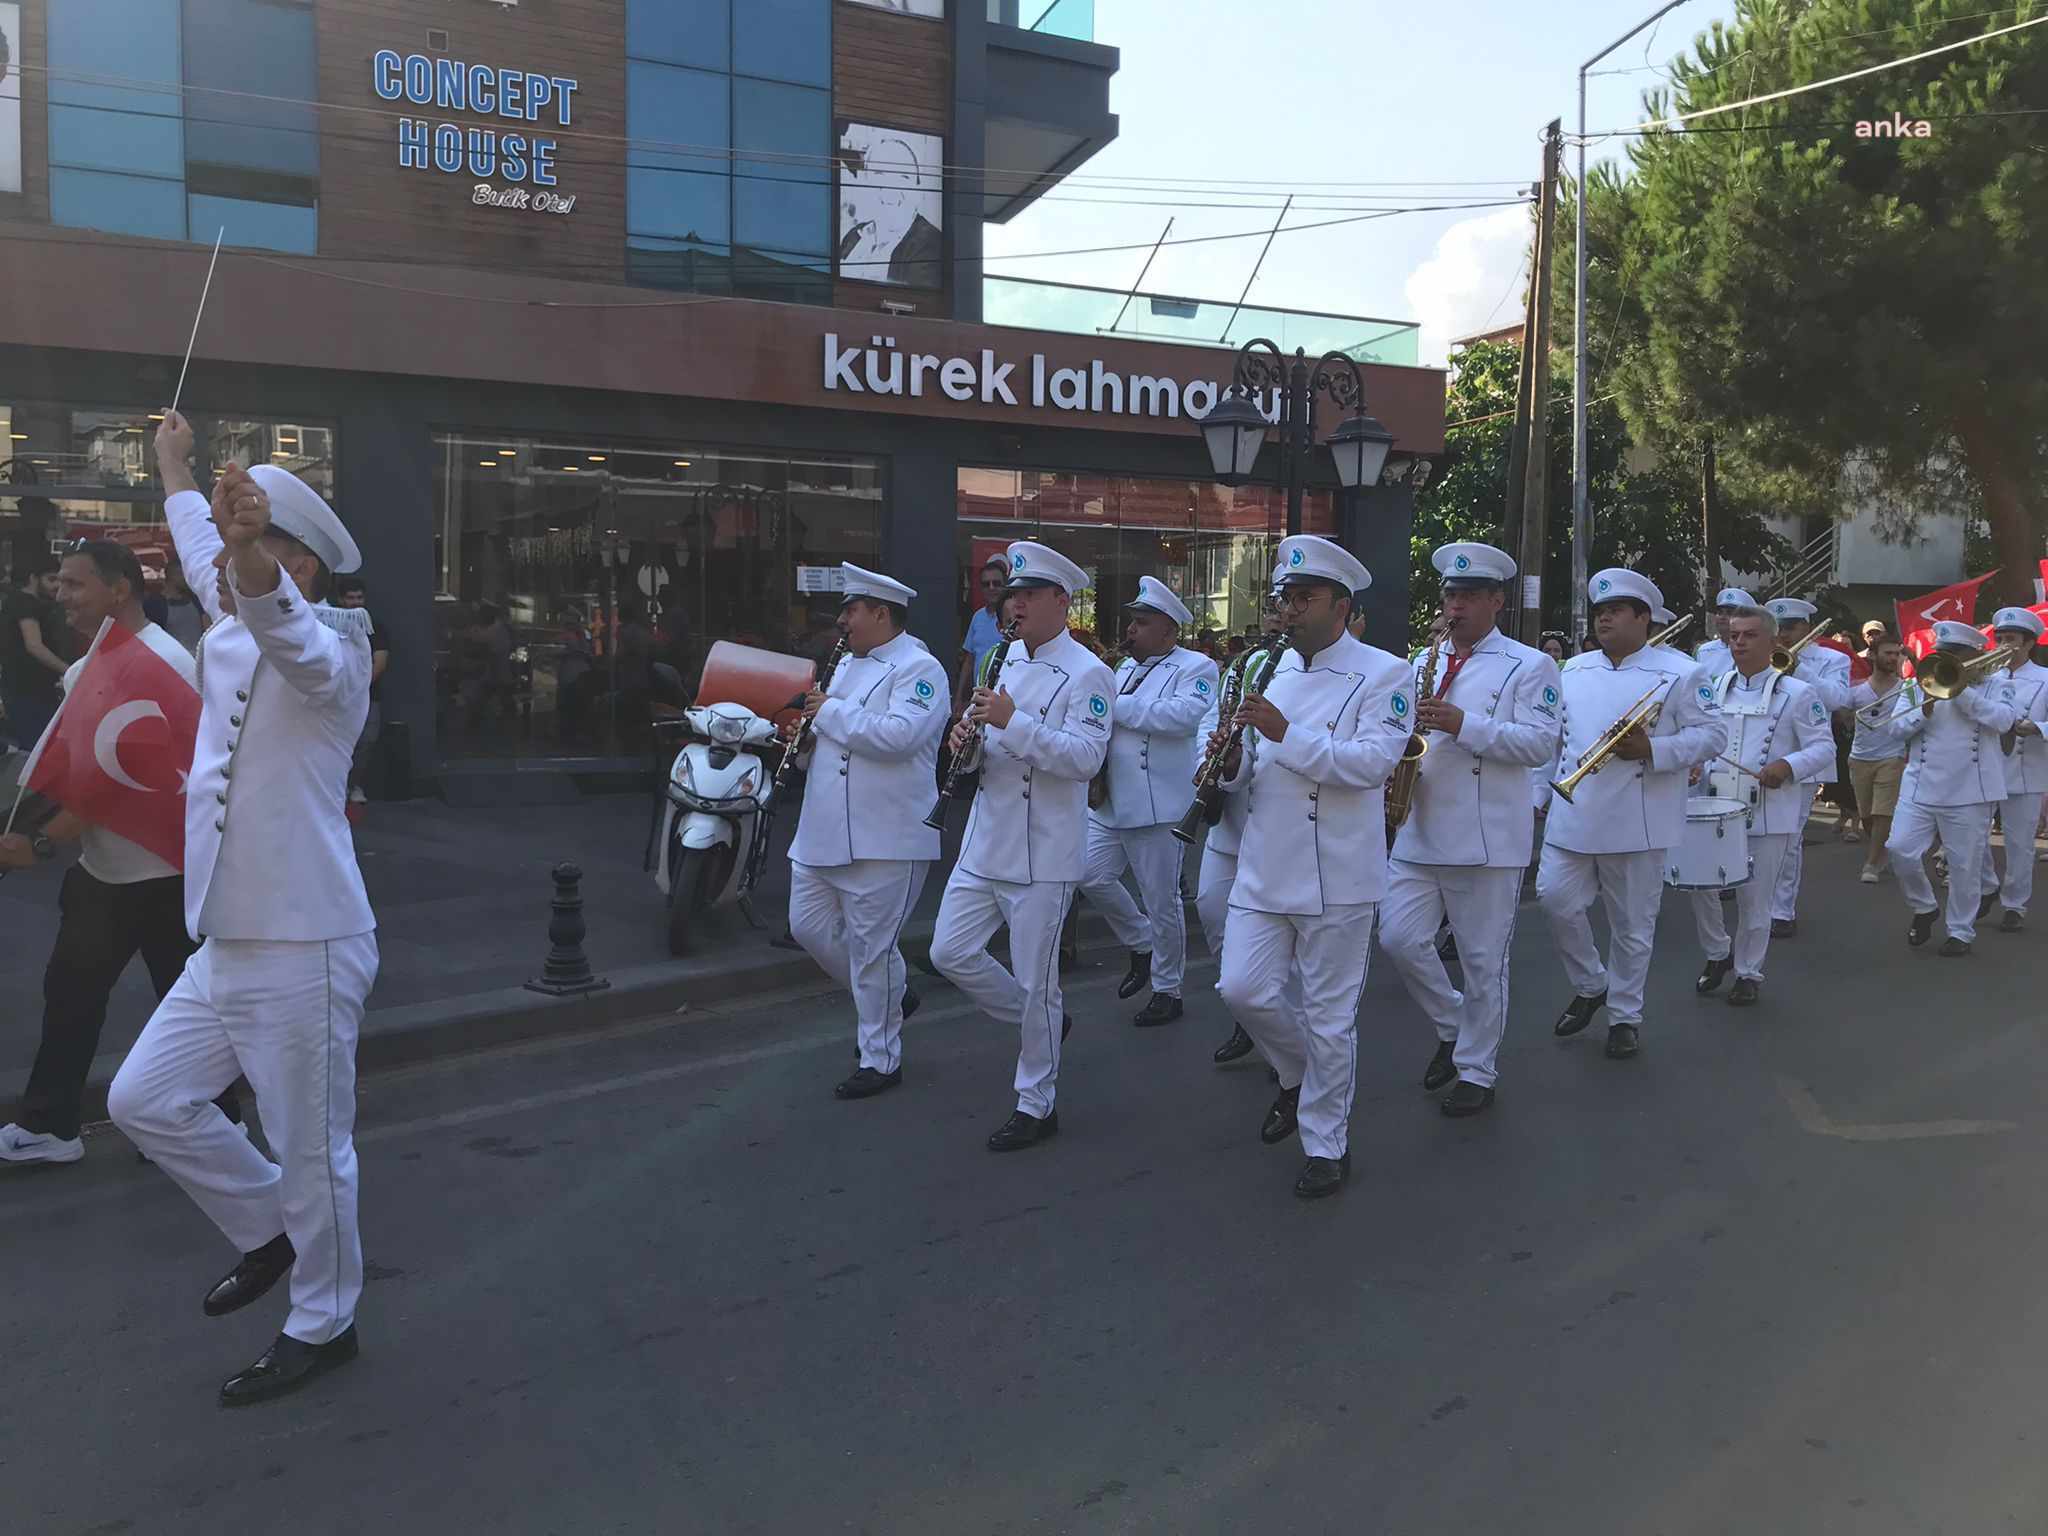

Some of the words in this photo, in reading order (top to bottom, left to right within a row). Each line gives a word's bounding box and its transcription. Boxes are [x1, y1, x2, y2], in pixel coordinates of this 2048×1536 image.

[374, 49, 577, 125] CONCEPT
[399, 117, 557, 185] HOUSE
[472, 183, 529, 210] Butik
[532, 191, 576, 214] Otel
[823, 333, 1018, 406] kürek
[1032, 353, 1311, 425] lahmau
